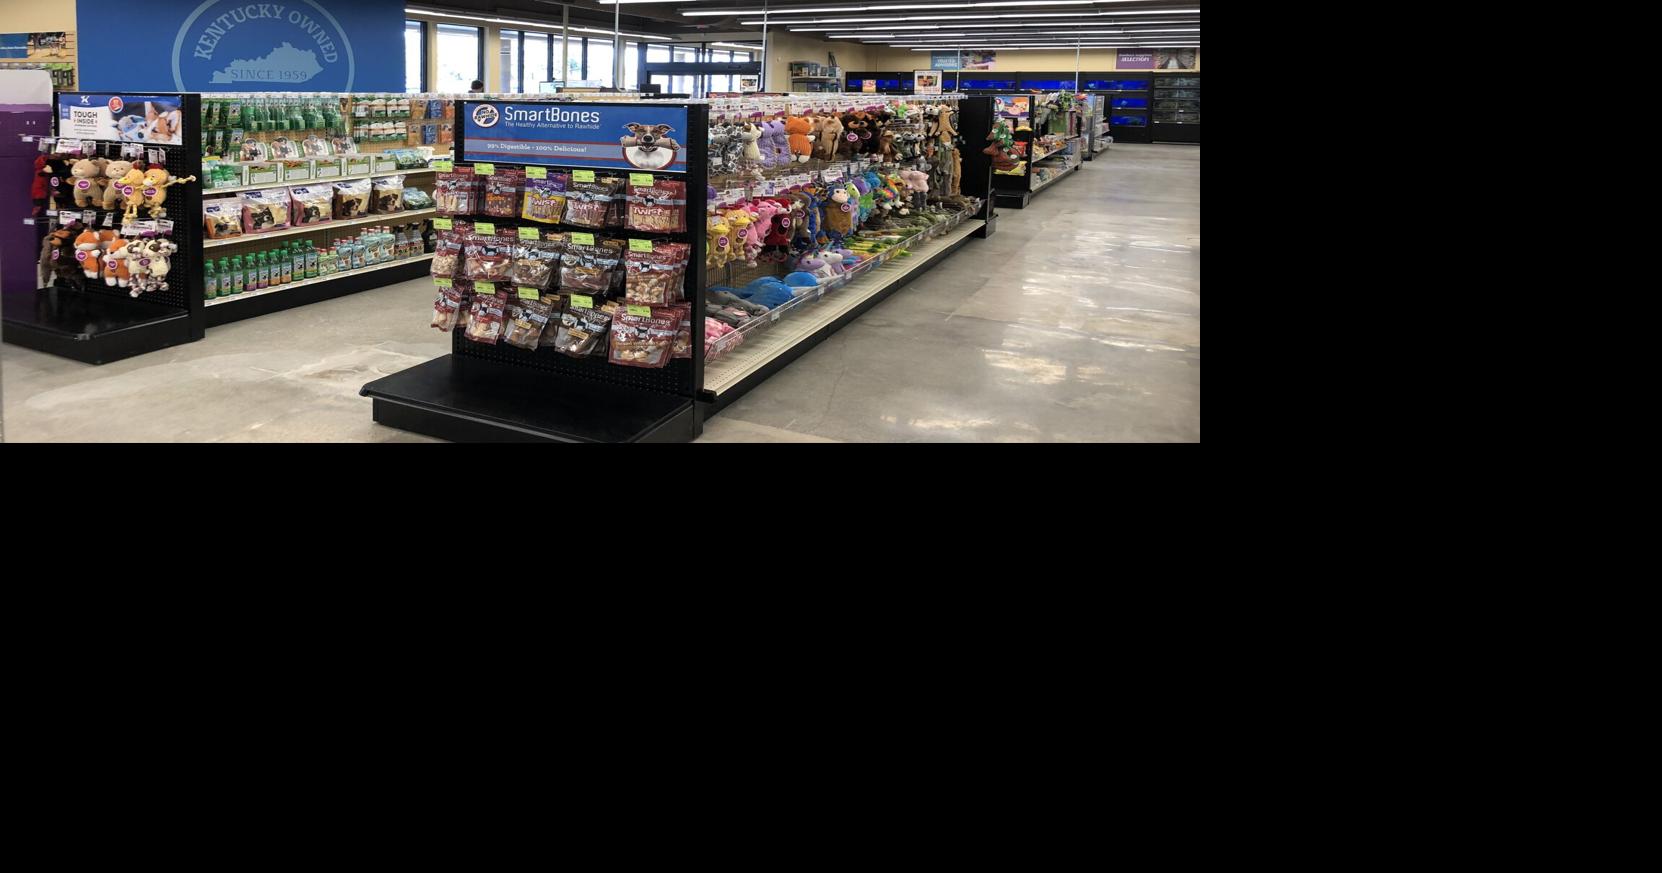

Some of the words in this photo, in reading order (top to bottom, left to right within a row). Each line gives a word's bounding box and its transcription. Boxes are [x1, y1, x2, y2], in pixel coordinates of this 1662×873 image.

[194, 4, 285, 60] KENTUCKY
[288, 10, 338, 63] OWNED
[231, 69, 274, 80] SINCE
[279, 70, 308, 80] 1959
[73, 111, 98, 119] TOUGH
[504, 106, 600, 123] SmartBones
[500, 143, 531, 151] Digestible
[465, 233, 514, 243] SmartBones
[567, 243, 613, 254] SmartBones
[621, 312, 673, 326] SmartBones
